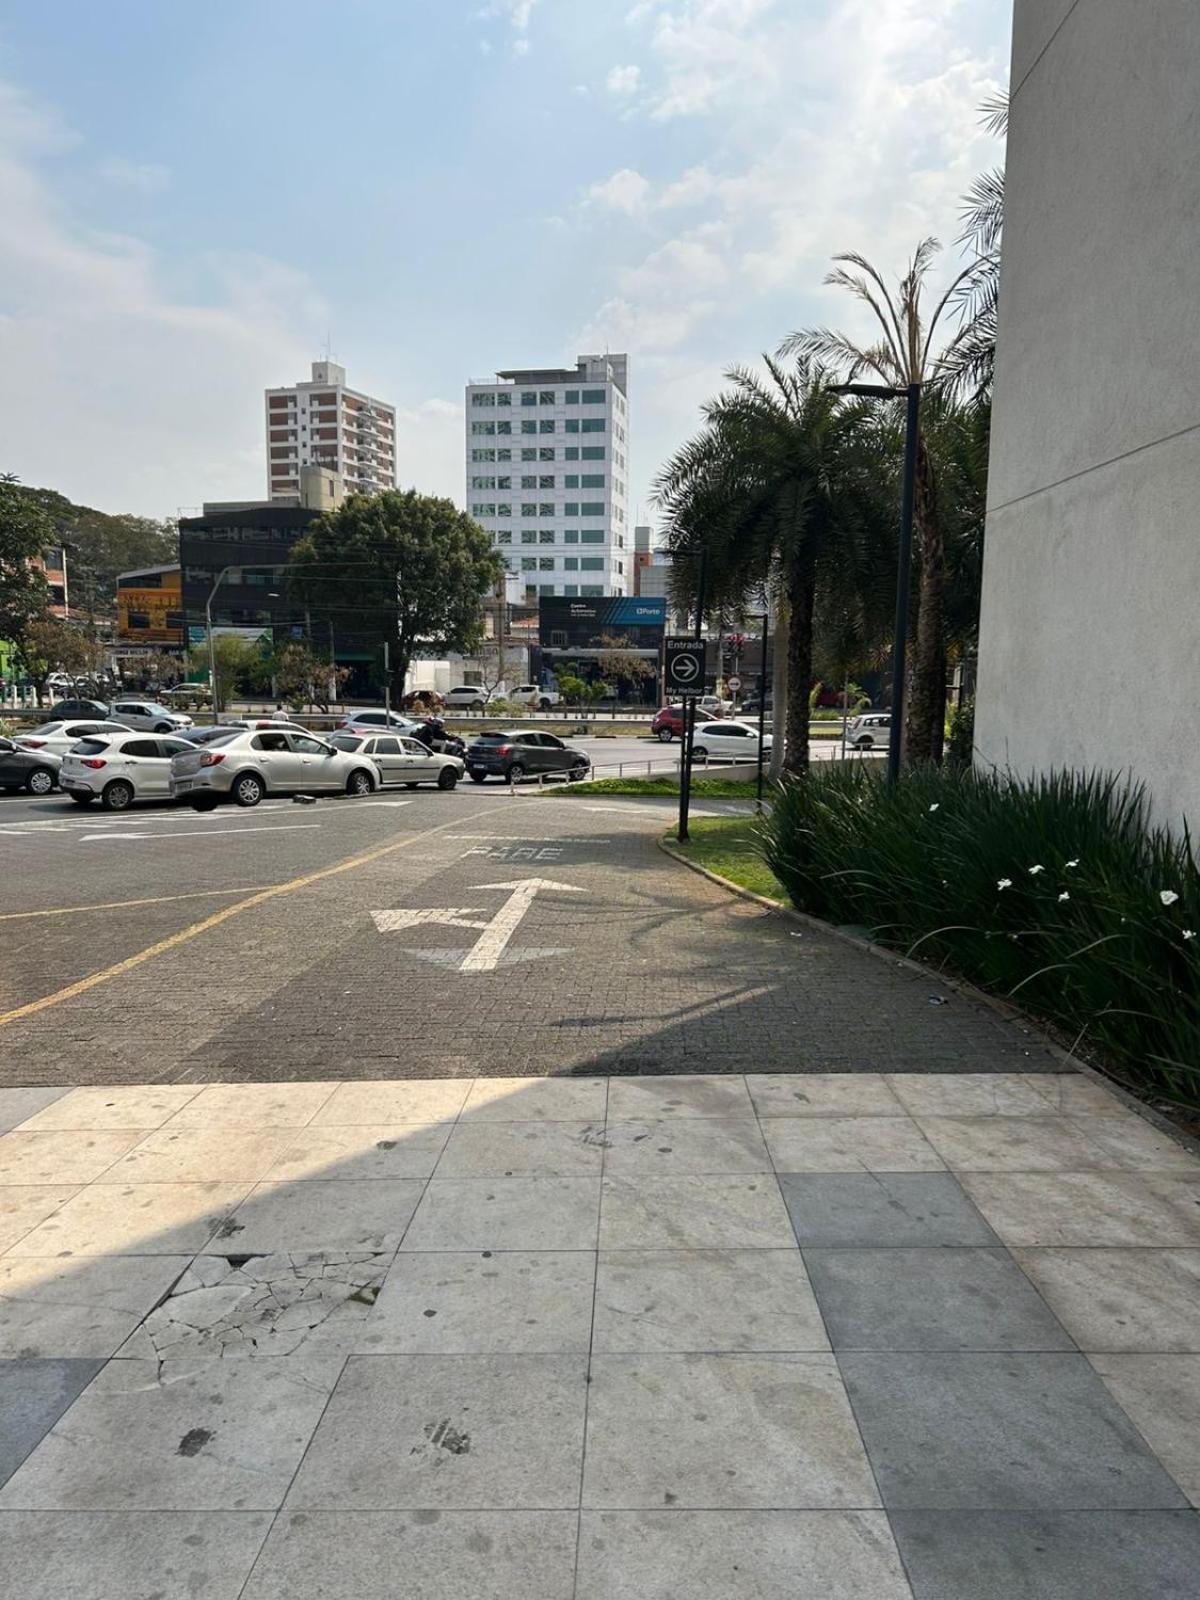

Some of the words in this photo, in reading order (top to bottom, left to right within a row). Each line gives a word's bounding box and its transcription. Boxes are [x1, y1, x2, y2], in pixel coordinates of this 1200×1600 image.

[642, 608, 661, 616] Porto
[667, 640, 704, 650] Entrada
[460, 846, 564, 860] PARE
